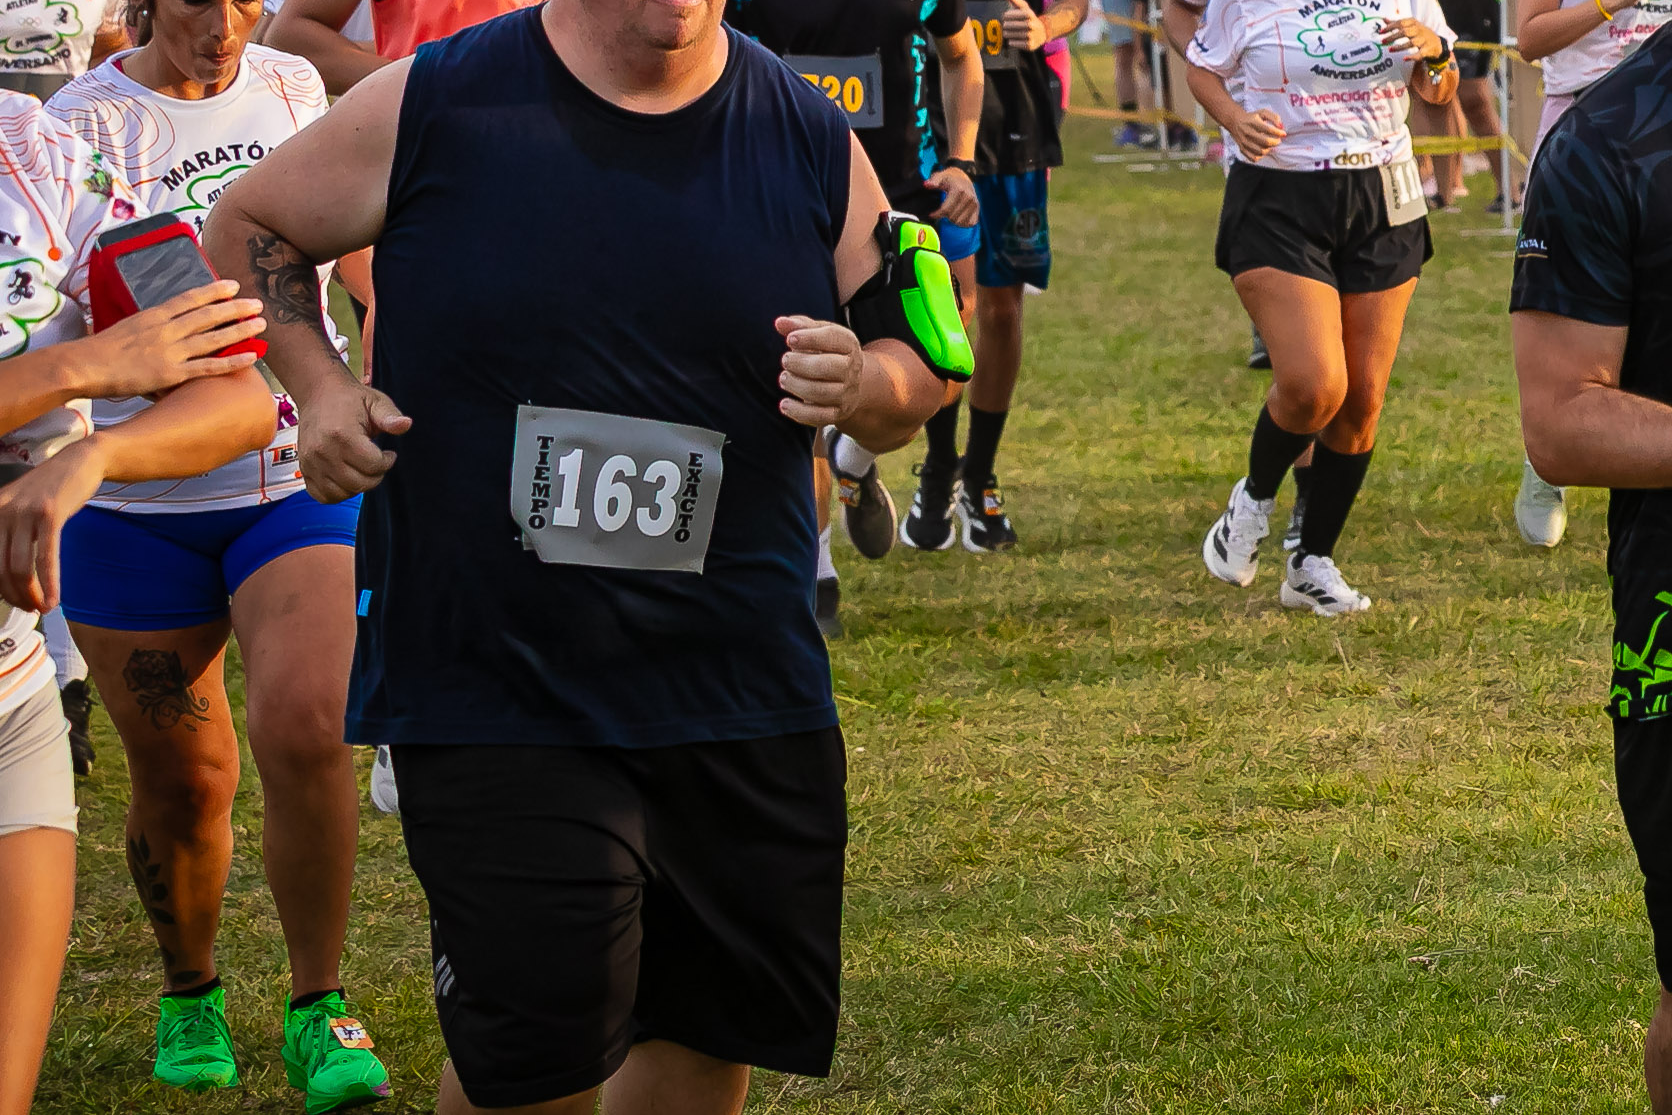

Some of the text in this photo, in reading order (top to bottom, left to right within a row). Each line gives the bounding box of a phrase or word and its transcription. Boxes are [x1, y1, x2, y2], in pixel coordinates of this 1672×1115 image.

[1310, 57, 1394, 81] ANIVERSARIO
[1290, 89, 1371, 108] Prevención
[161, 140, 275, 192] MARATÓ
[1334, 148, 1373, 166] don
[528, 435, 555, 530] TIEMPO
[551, 448, 682, 537] 163
[674, 452, 714, 543] EXACTO
